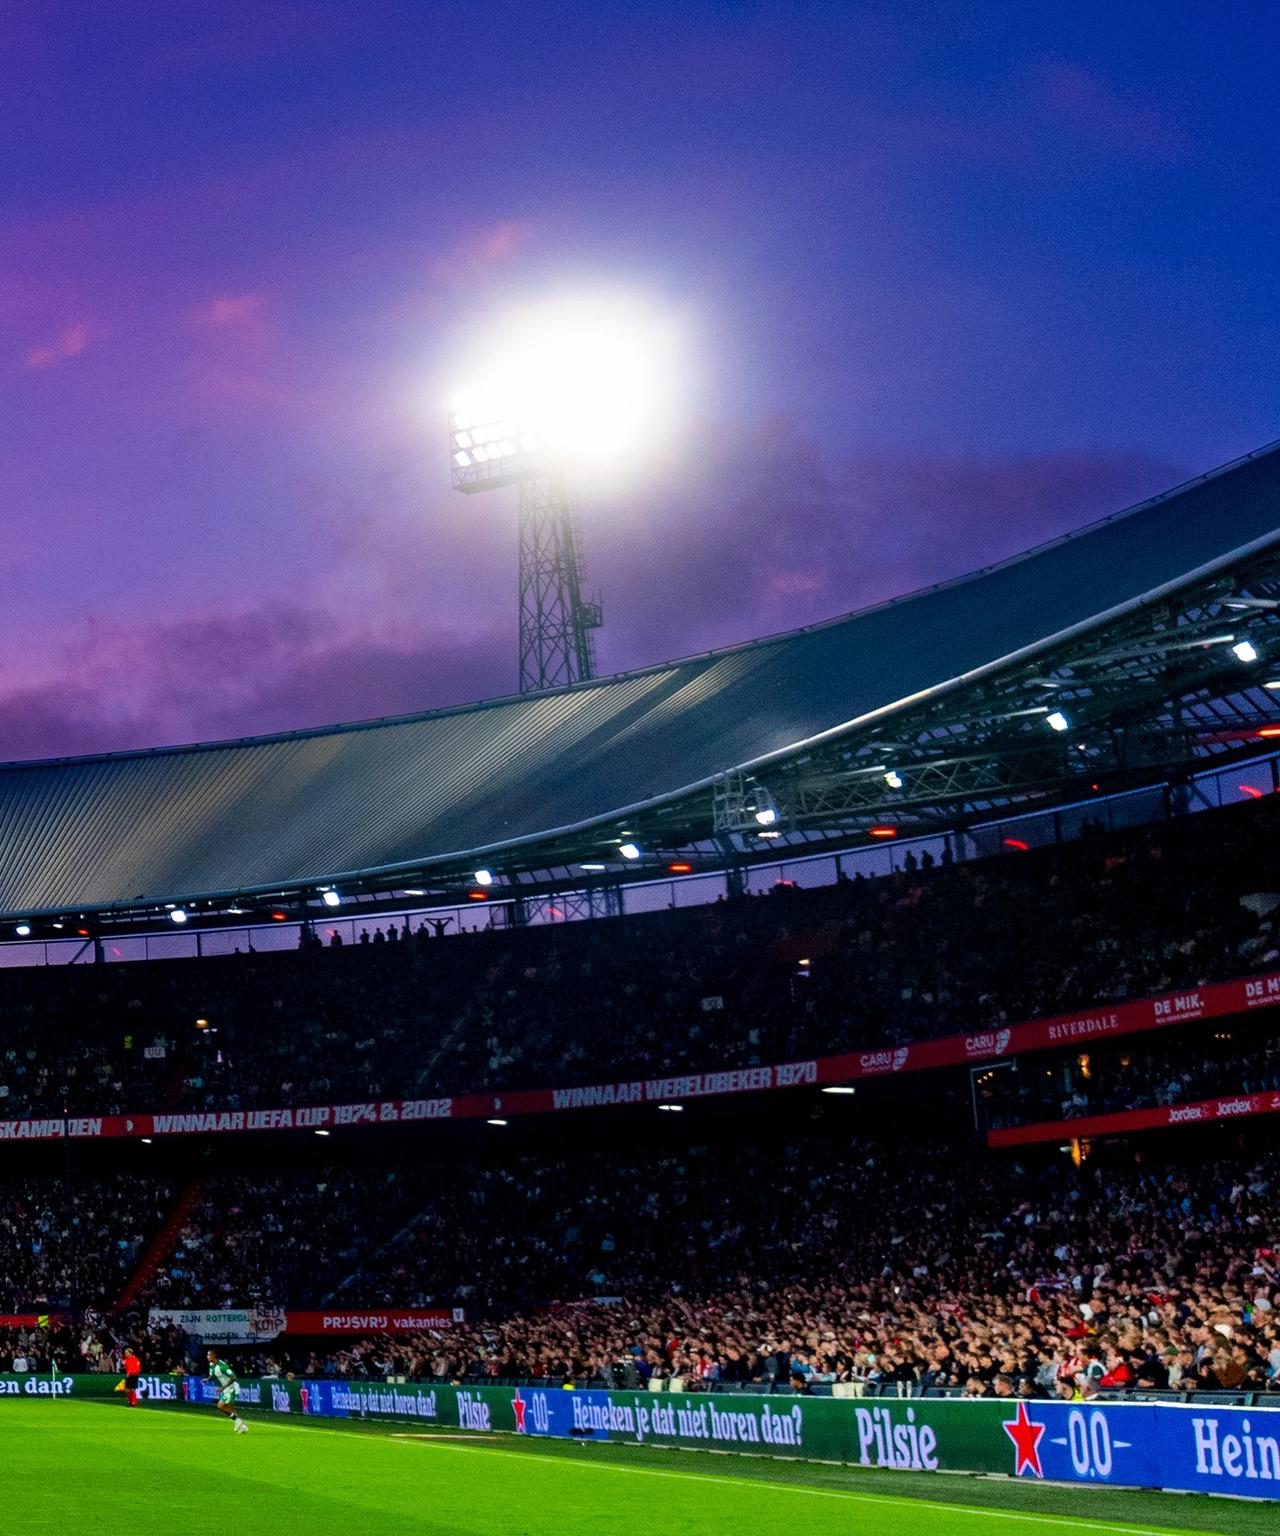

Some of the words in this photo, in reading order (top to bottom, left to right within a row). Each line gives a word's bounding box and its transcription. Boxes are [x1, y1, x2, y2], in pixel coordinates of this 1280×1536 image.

[1267, 977, 1280, 993] M
[1154, 1000, 1171, 1015] DE
[1048, 1014, 1118, 1039] RIVERDALE
[964, 1034, 995, 1050] CARU
[860, 1052, 891, 1067] CARU
[552, 1081, 643, 1109] WINNAAR
[645, 1065, 771, 1100] WERELDBEKER
[775, 1061, 817, 1086] 1970
[152, 1112, 244, 1133] WINNAAR
[247, 1109, 294, 1130] UEFA
[296, 1107, 330, 1126] CUP
[333, 1103, 377, 1125] 1974
[379, 1101, 398, 1121] &
[401, 1098, 452, 1119] 2002
[206, 1314, 249, 1322] ROTTERDA
[323, 1316, 387, 1329] PRIJSVRIJ
[393, 1316, 452, 1329] vakanties
[25, 1377, 73, 1395] dan?
[331, 1386, 360, 1410] Heineken
[394, 1389, 417, 1414] horen
[417, 1390, 437, 1417] dan?
[456, 1391, 491, 1430] Pilsie
[572, 1394, 635, 1432] Heineken
[634, 1399, 650, 1441] je
[651, 1398, 675, 1437] dat
[676, 1400, 707, 1439] niet
[710, 1401, 758, 1442] horen
[760, 1404, 803, 1446] dan?
[855, 1407, 939, 1470] Pilsie
[1191, 1418, 1280, 1480] Hein
